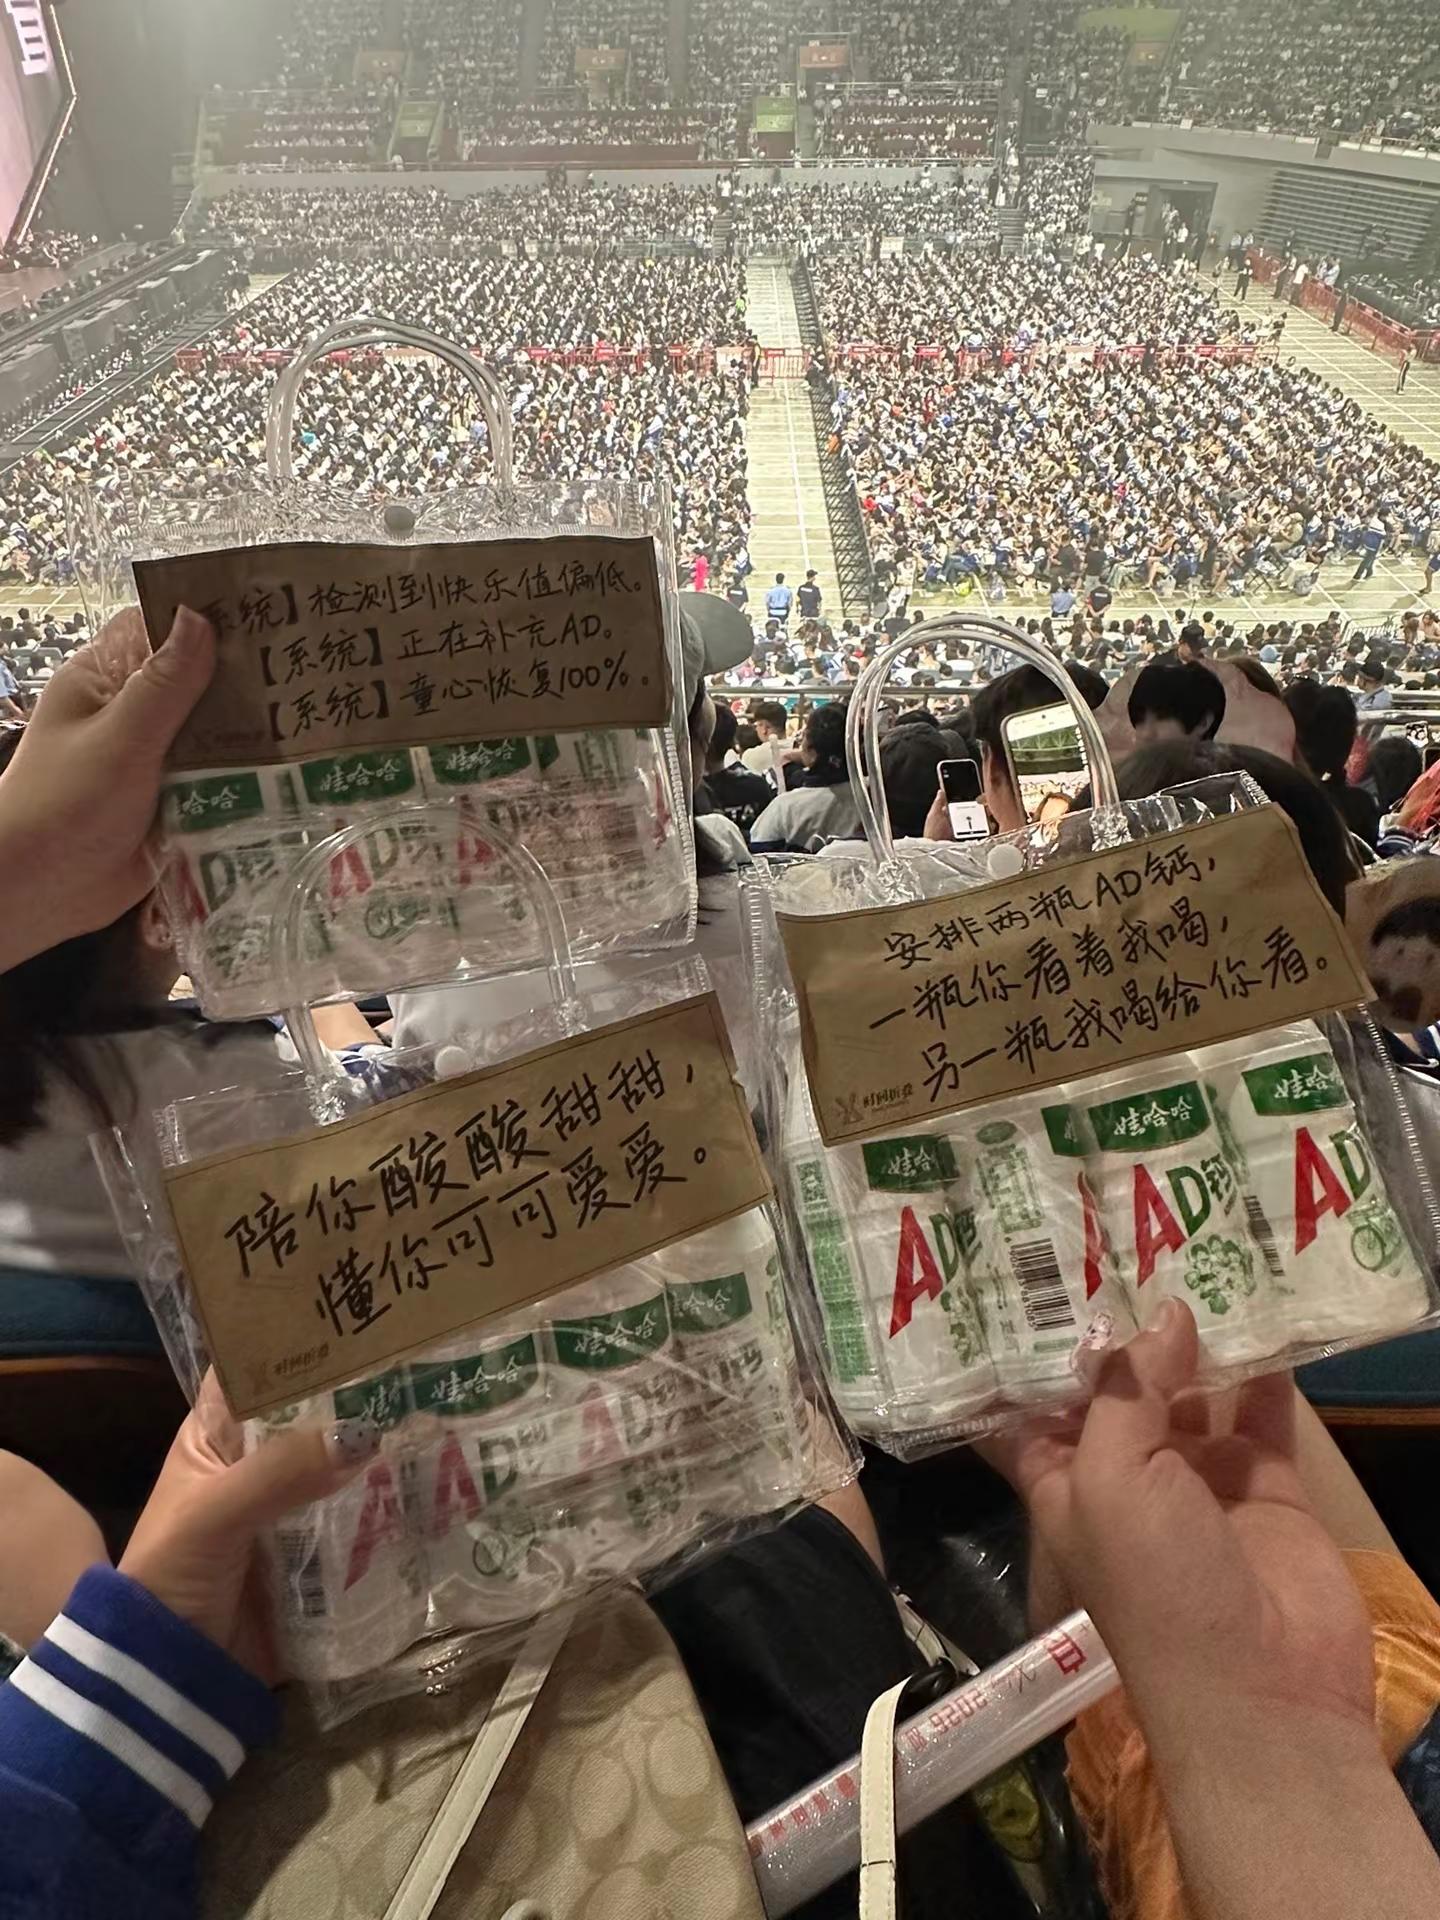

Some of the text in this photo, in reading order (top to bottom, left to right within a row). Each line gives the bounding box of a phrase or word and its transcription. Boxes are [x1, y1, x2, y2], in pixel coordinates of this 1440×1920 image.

[172, 560, 642, 635] 系统】检测到快乐值偏低。
[319, 758, 400, 793] 娃哈哈
[445, 738, 515, 772] 娃哈哈
[882, 847, 1217, 971] 安排两瓶AD钙，
[868, 896, 1230, 1031] 一瓶你看着我喝，
[921, 925, 1329, 1102] 另一瓶我喝给你看。
[1113, 1095, 1193, 1136] 娃哈哈
[223, 1048, 695, 1279] 陪你酸酸甜甜，
[887, 1144, 936, 1177] 娃哈
[316, 1120, 707, 1337] 懂你可可爱爱。
[574, 1310, 657, 1356] 娃哈哈
[430, 1355, 523, 1403] 娃哈哈
